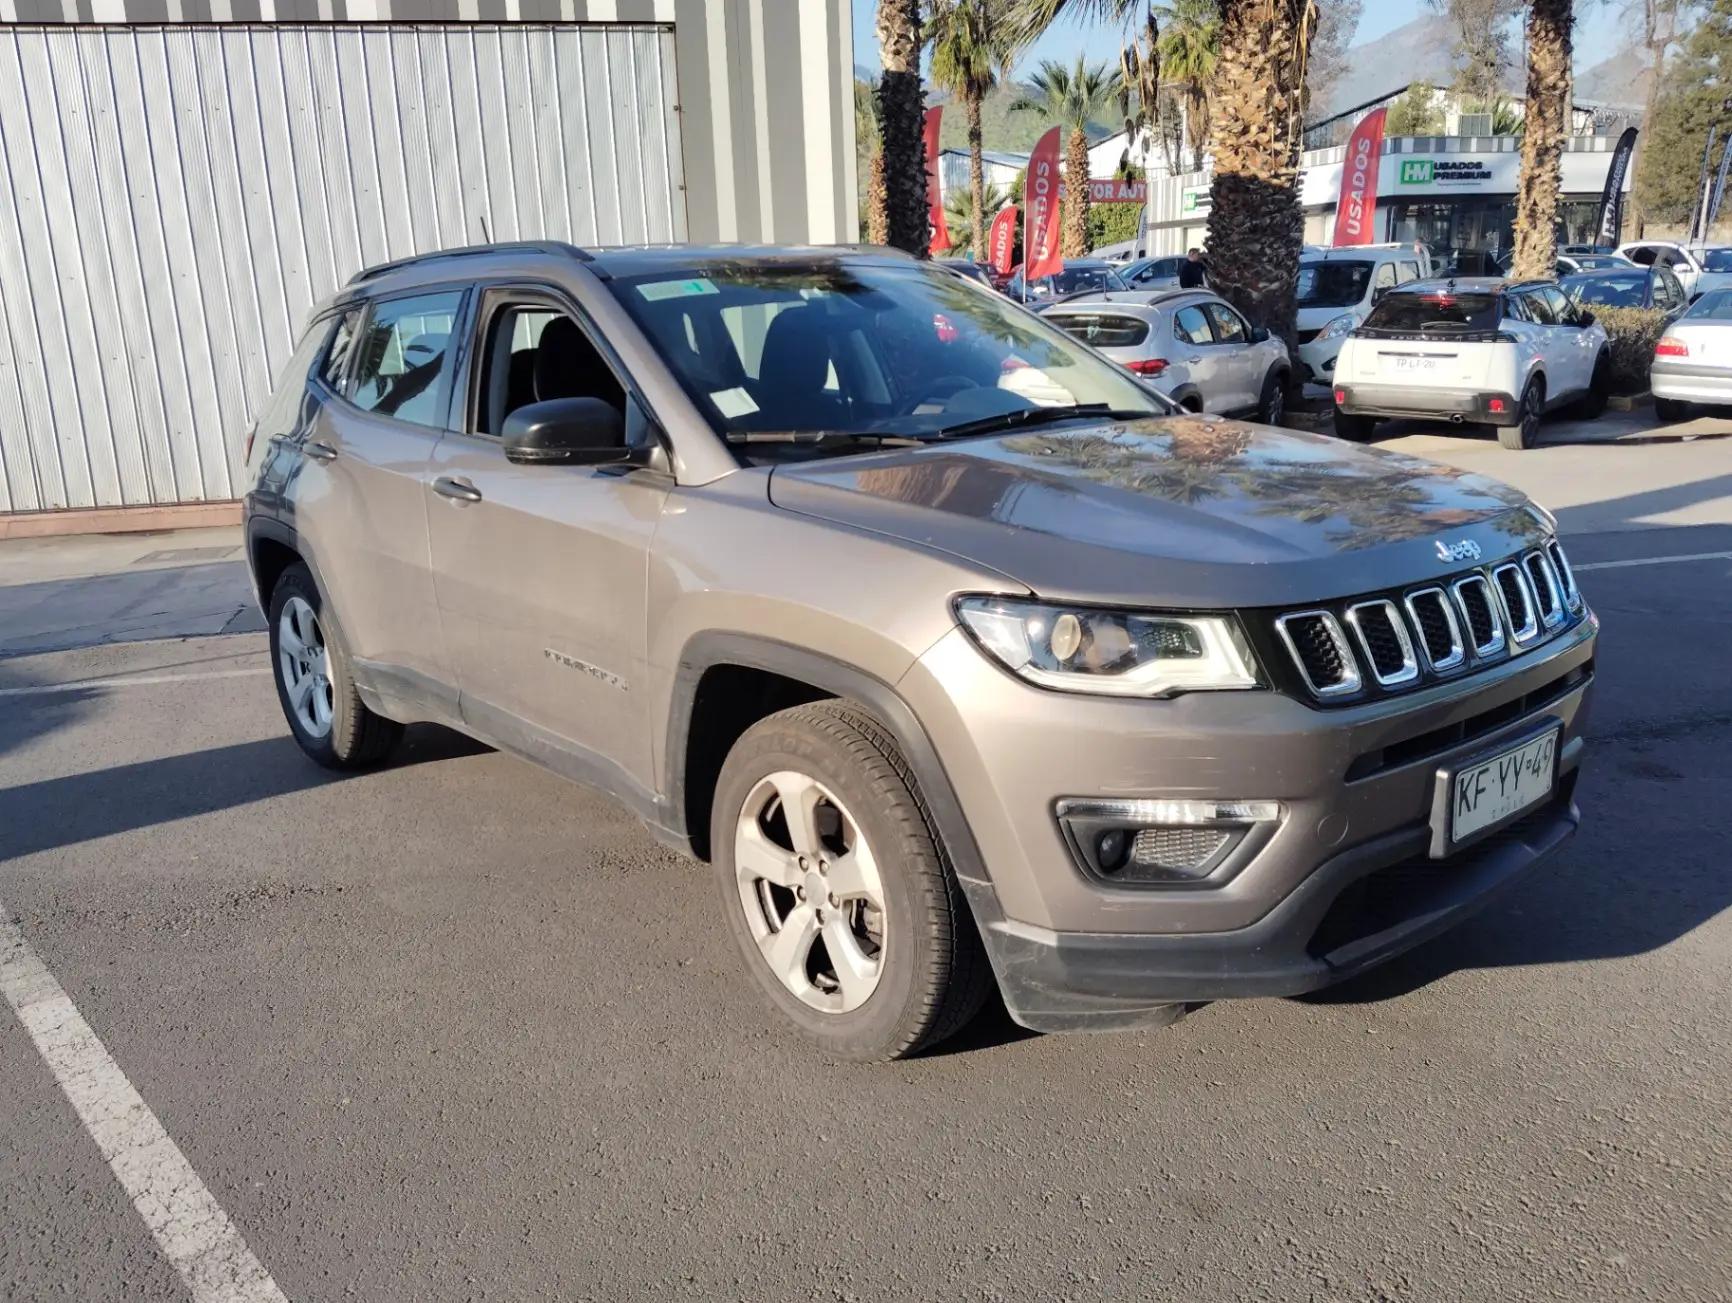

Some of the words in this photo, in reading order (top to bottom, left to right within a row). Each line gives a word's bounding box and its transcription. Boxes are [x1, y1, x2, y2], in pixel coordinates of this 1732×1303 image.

[1433, 171, 1492, 180] PREMIUM
[1434, 161, 1483, 170] USADOS
[1346, 137, 1370, 236] USADOS
[1033, 160, 1049, 261] USADOS
[1435, 540, 1481, 562] Jeep
